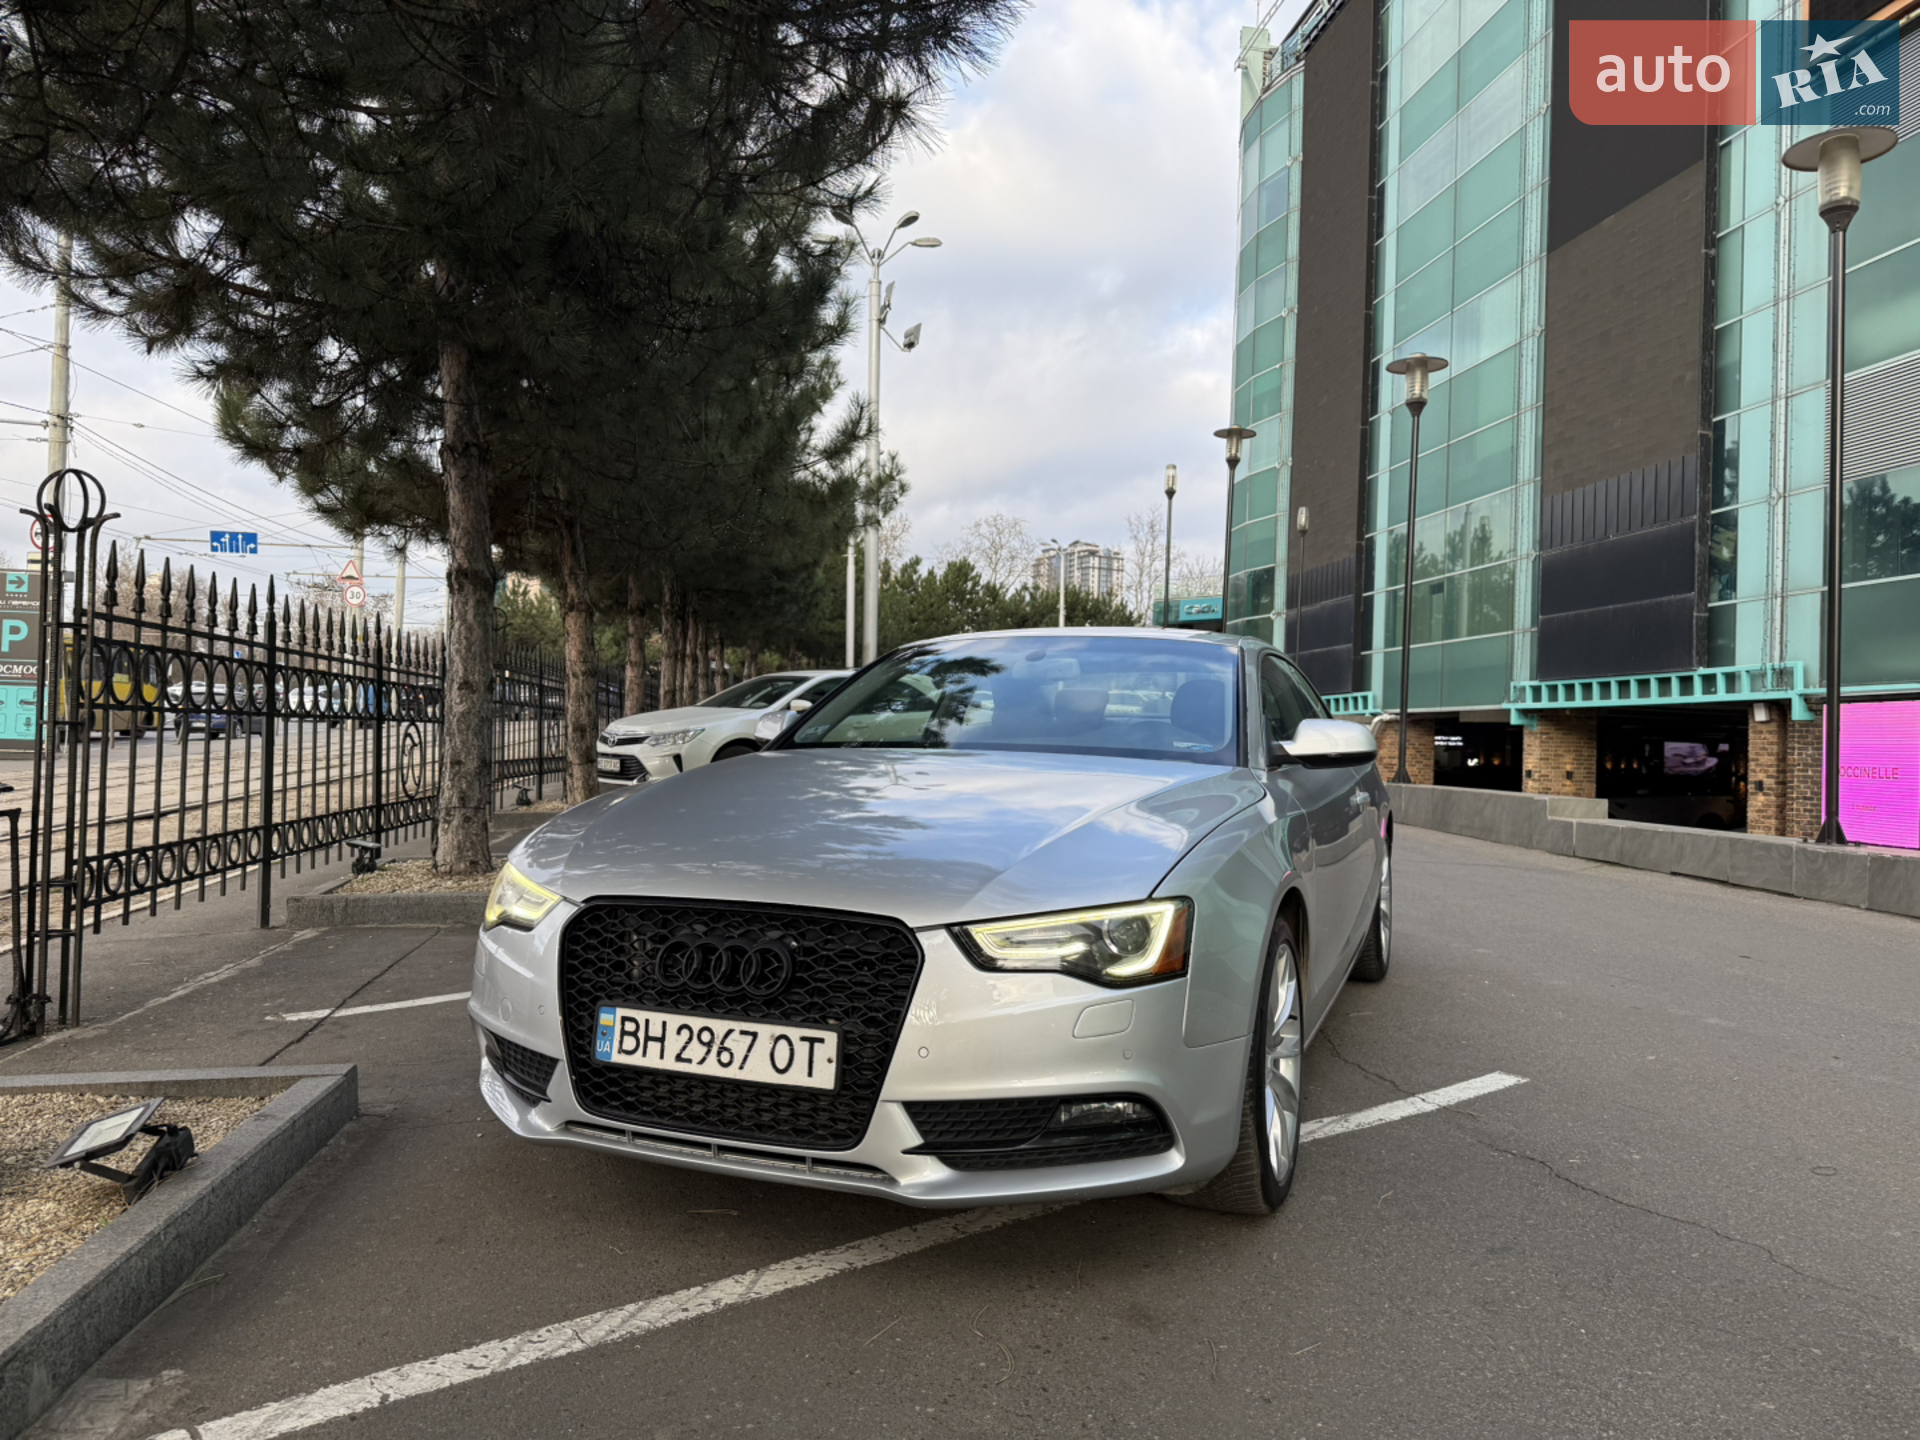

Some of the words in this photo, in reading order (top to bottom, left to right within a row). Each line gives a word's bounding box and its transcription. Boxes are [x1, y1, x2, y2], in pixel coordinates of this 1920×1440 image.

[349, 591, 361, 599] 30
[1, 619, 28, 652] P
[1838, 766, 1900, 779] OCCINELLE
[596, 1039, 612, 1053] UA
[617, 1016, 667, 1060] BH
[675, 1023, 759, 1070] 2967
[769, 1034, 825, 1078] OT
